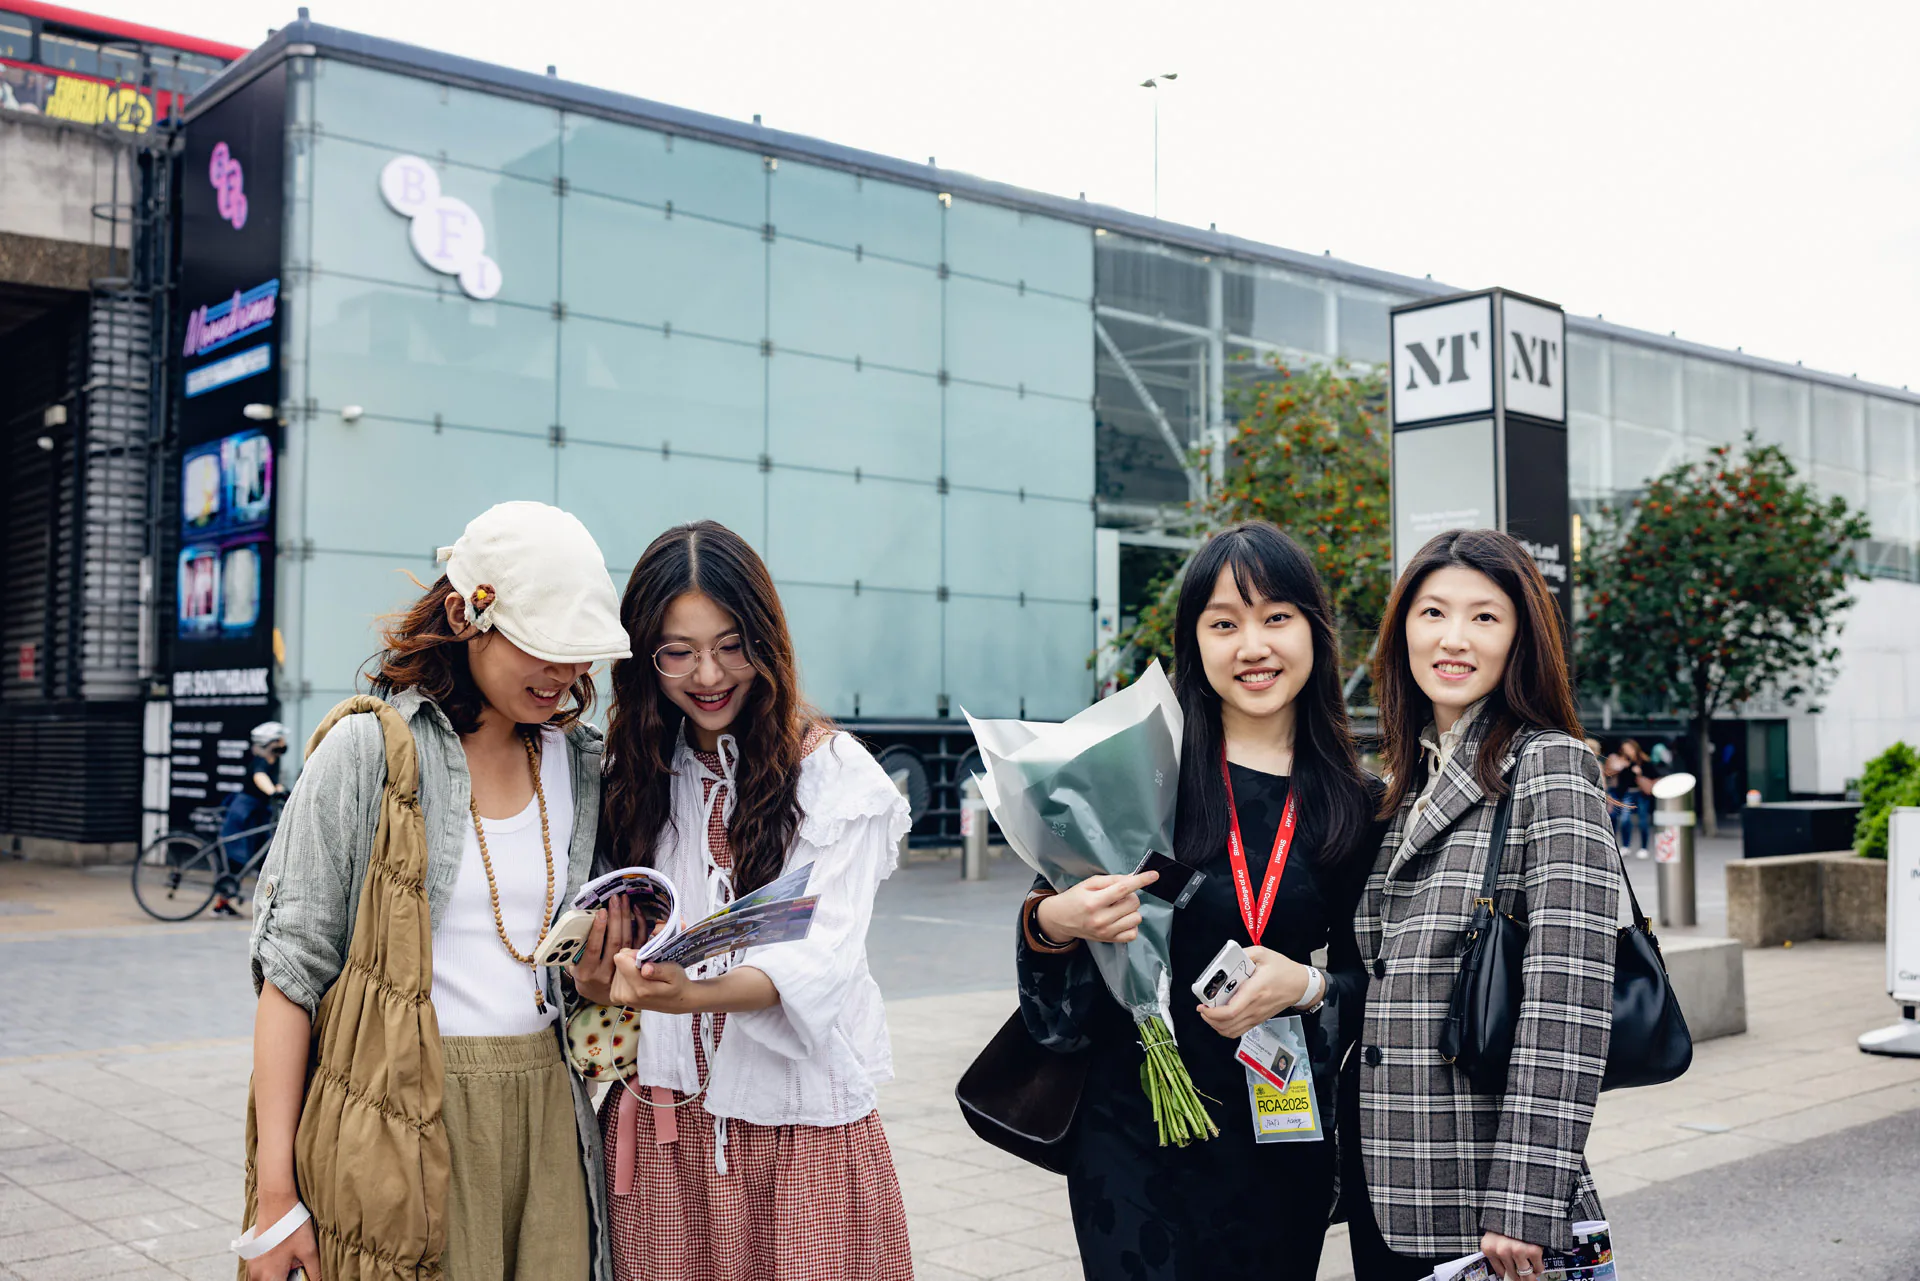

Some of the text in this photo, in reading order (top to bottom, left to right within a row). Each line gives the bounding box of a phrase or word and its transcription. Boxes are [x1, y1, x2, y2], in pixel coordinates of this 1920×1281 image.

[398, 163, 490, 292] BFI
[1405, 331, 1480, 391] NT
[1510, 331, 1557, 388] NT
[1229, 830, 1240, 856] Student
[1274, 838, 1287, 864] Student
[1236, 869, 1245, 879] Art
[1265, 875, 1276, 892] Royal
[1241, 885, 1251, 910] College
[1258, 892, 1271, 916] College
[1245, 910, 1254, 929] Royal
[1257, 1096, 1309, 1113] RCA2025
